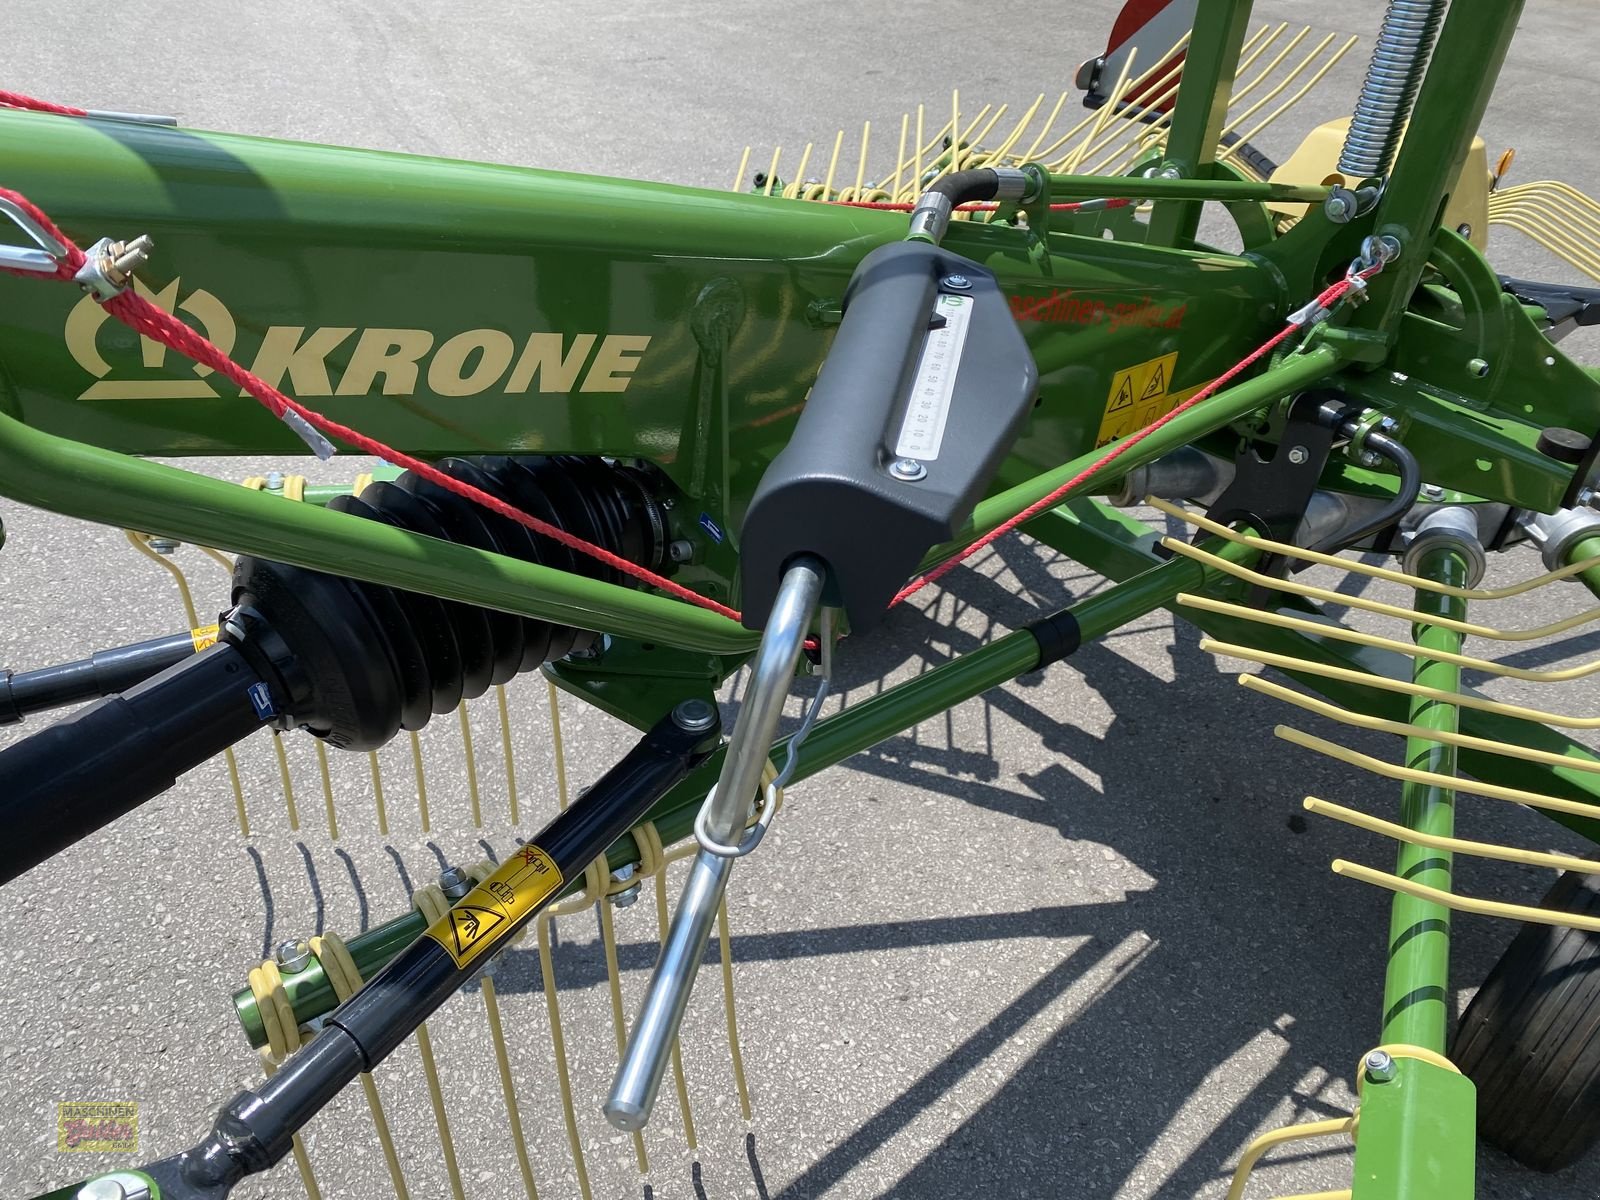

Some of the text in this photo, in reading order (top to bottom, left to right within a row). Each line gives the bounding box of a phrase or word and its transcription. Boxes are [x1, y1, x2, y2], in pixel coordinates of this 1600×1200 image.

[238, 325, 653, 398] KRONE
[917, 414, 929, 423] 20
[913, 429, 925, 438] 10
